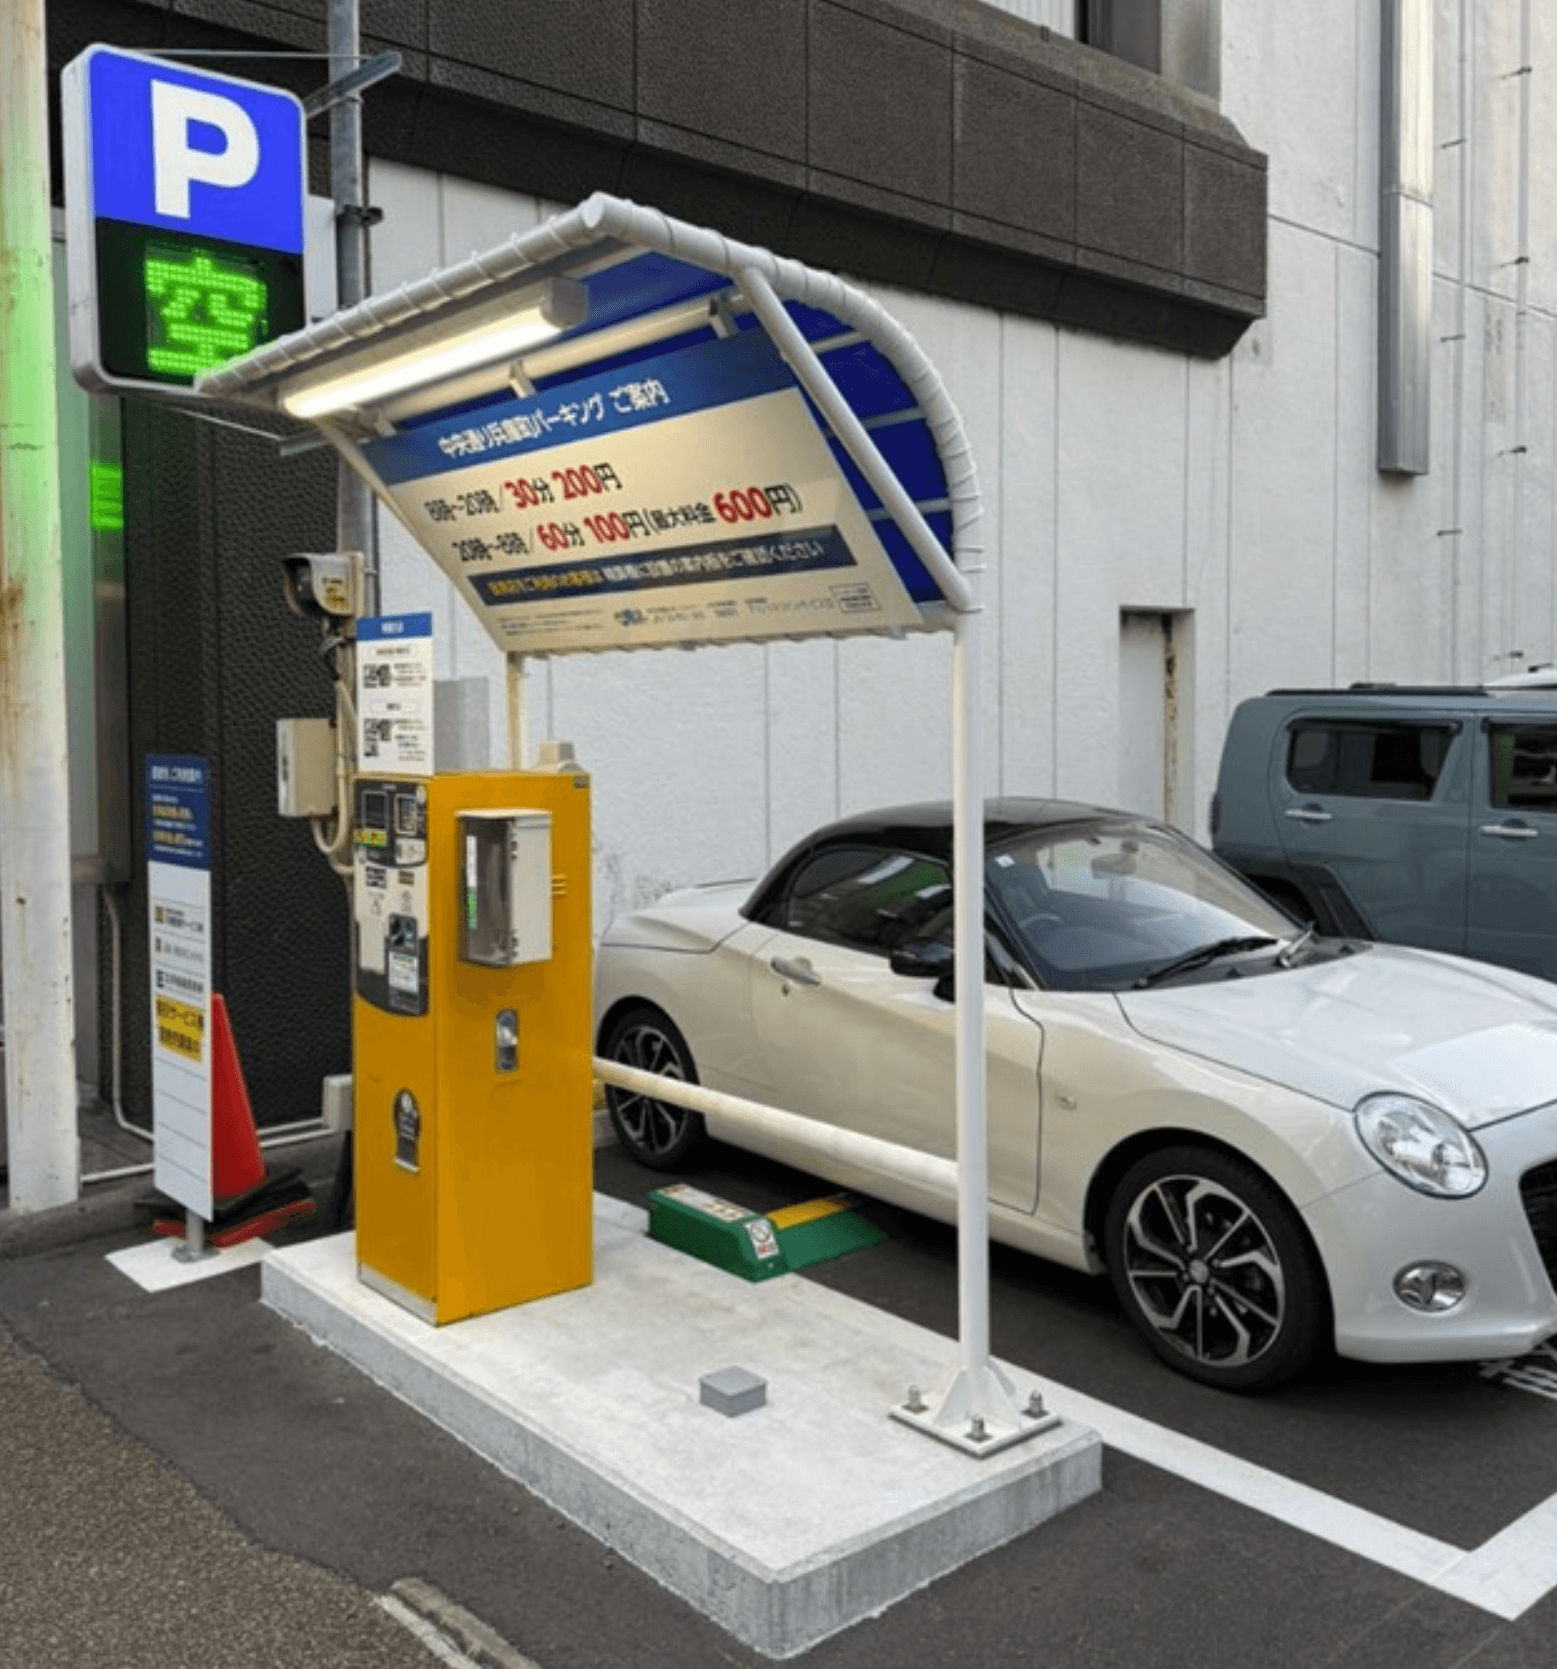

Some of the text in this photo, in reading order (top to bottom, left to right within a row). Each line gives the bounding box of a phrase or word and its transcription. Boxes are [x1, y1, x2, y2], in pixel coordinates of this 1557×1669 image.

[150, 79, 261, 219] P
[145, 256, 265, 374] 空
[608, 378, 671, 413] ご案内
[551, 462, 623, 500] 200円
